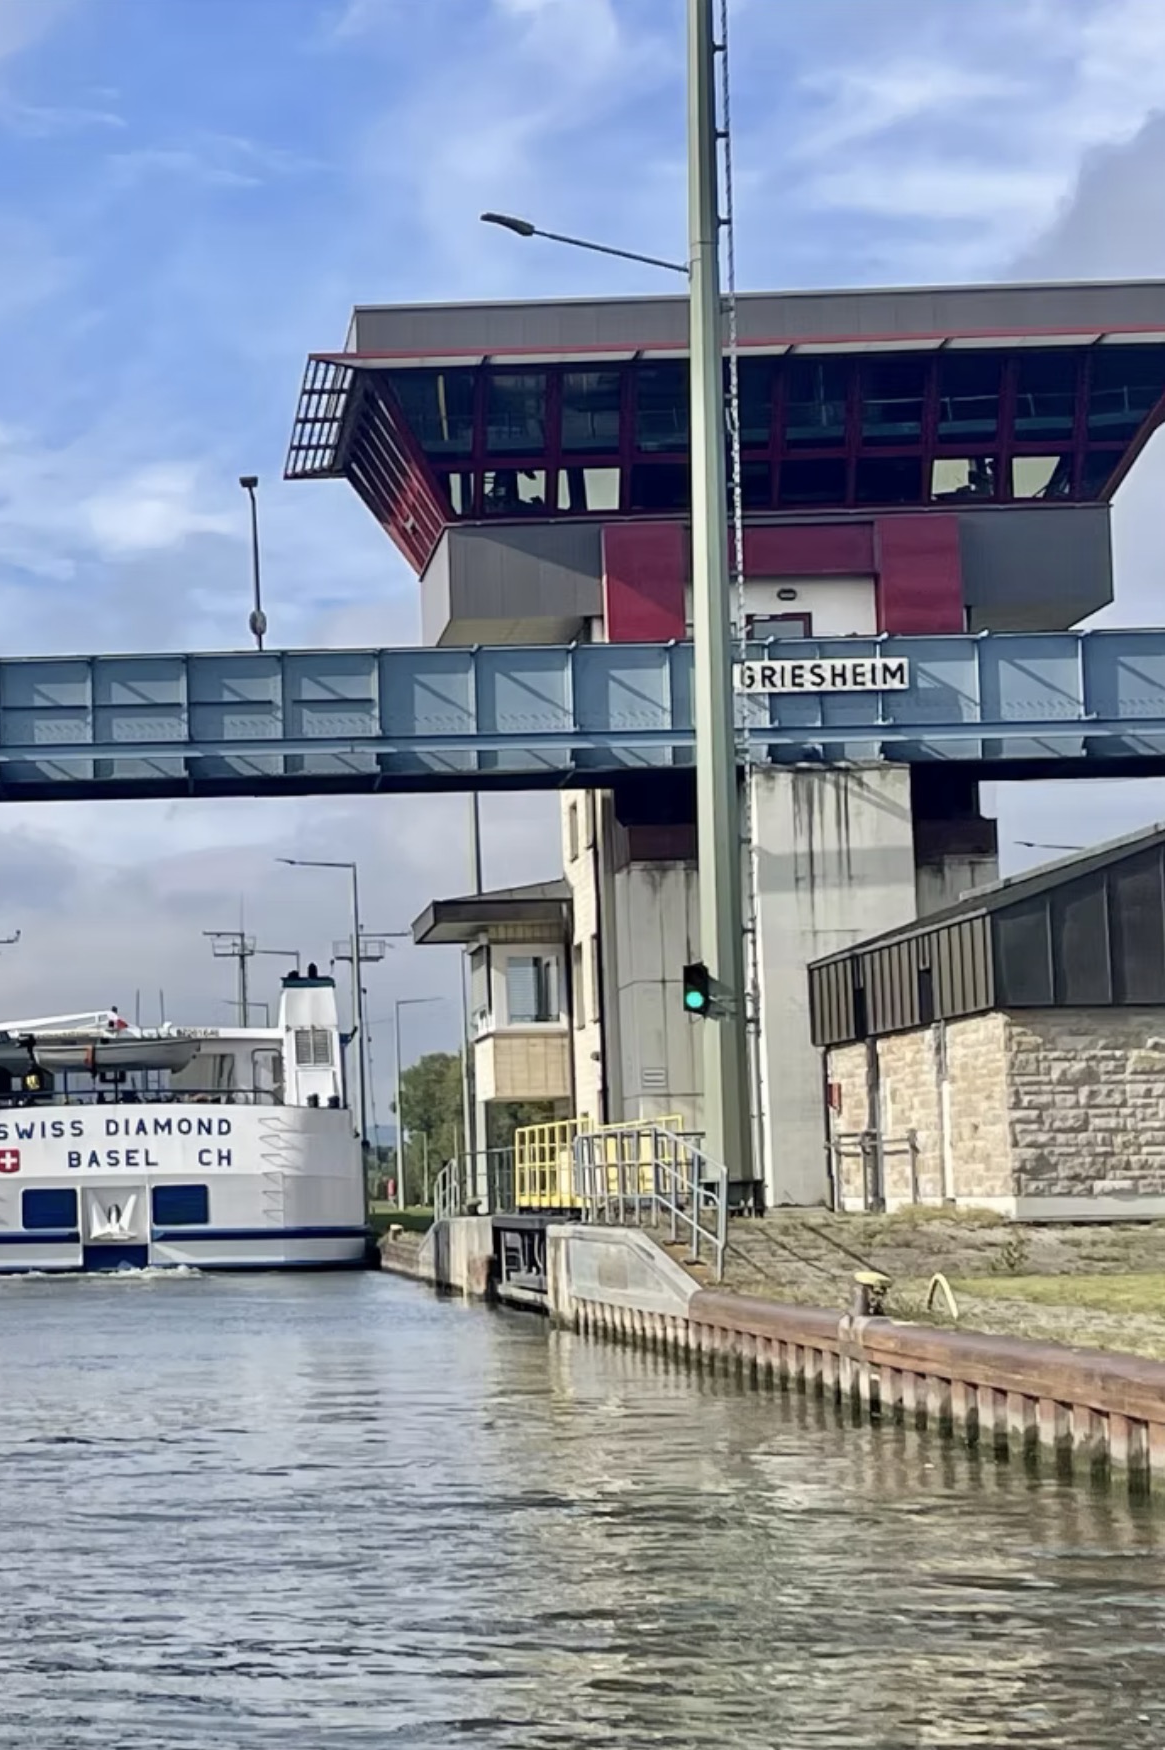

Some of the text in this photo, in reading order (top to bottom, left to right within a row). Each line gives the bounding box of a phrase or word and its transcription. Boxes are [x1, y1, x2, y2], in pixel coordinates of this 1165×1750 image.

[742, 662, 905, 689] GRIESHEIM
[104, 1117, 233, 1136] DIAMOND
[67, 1148, 233, 1168] BASEL CH
